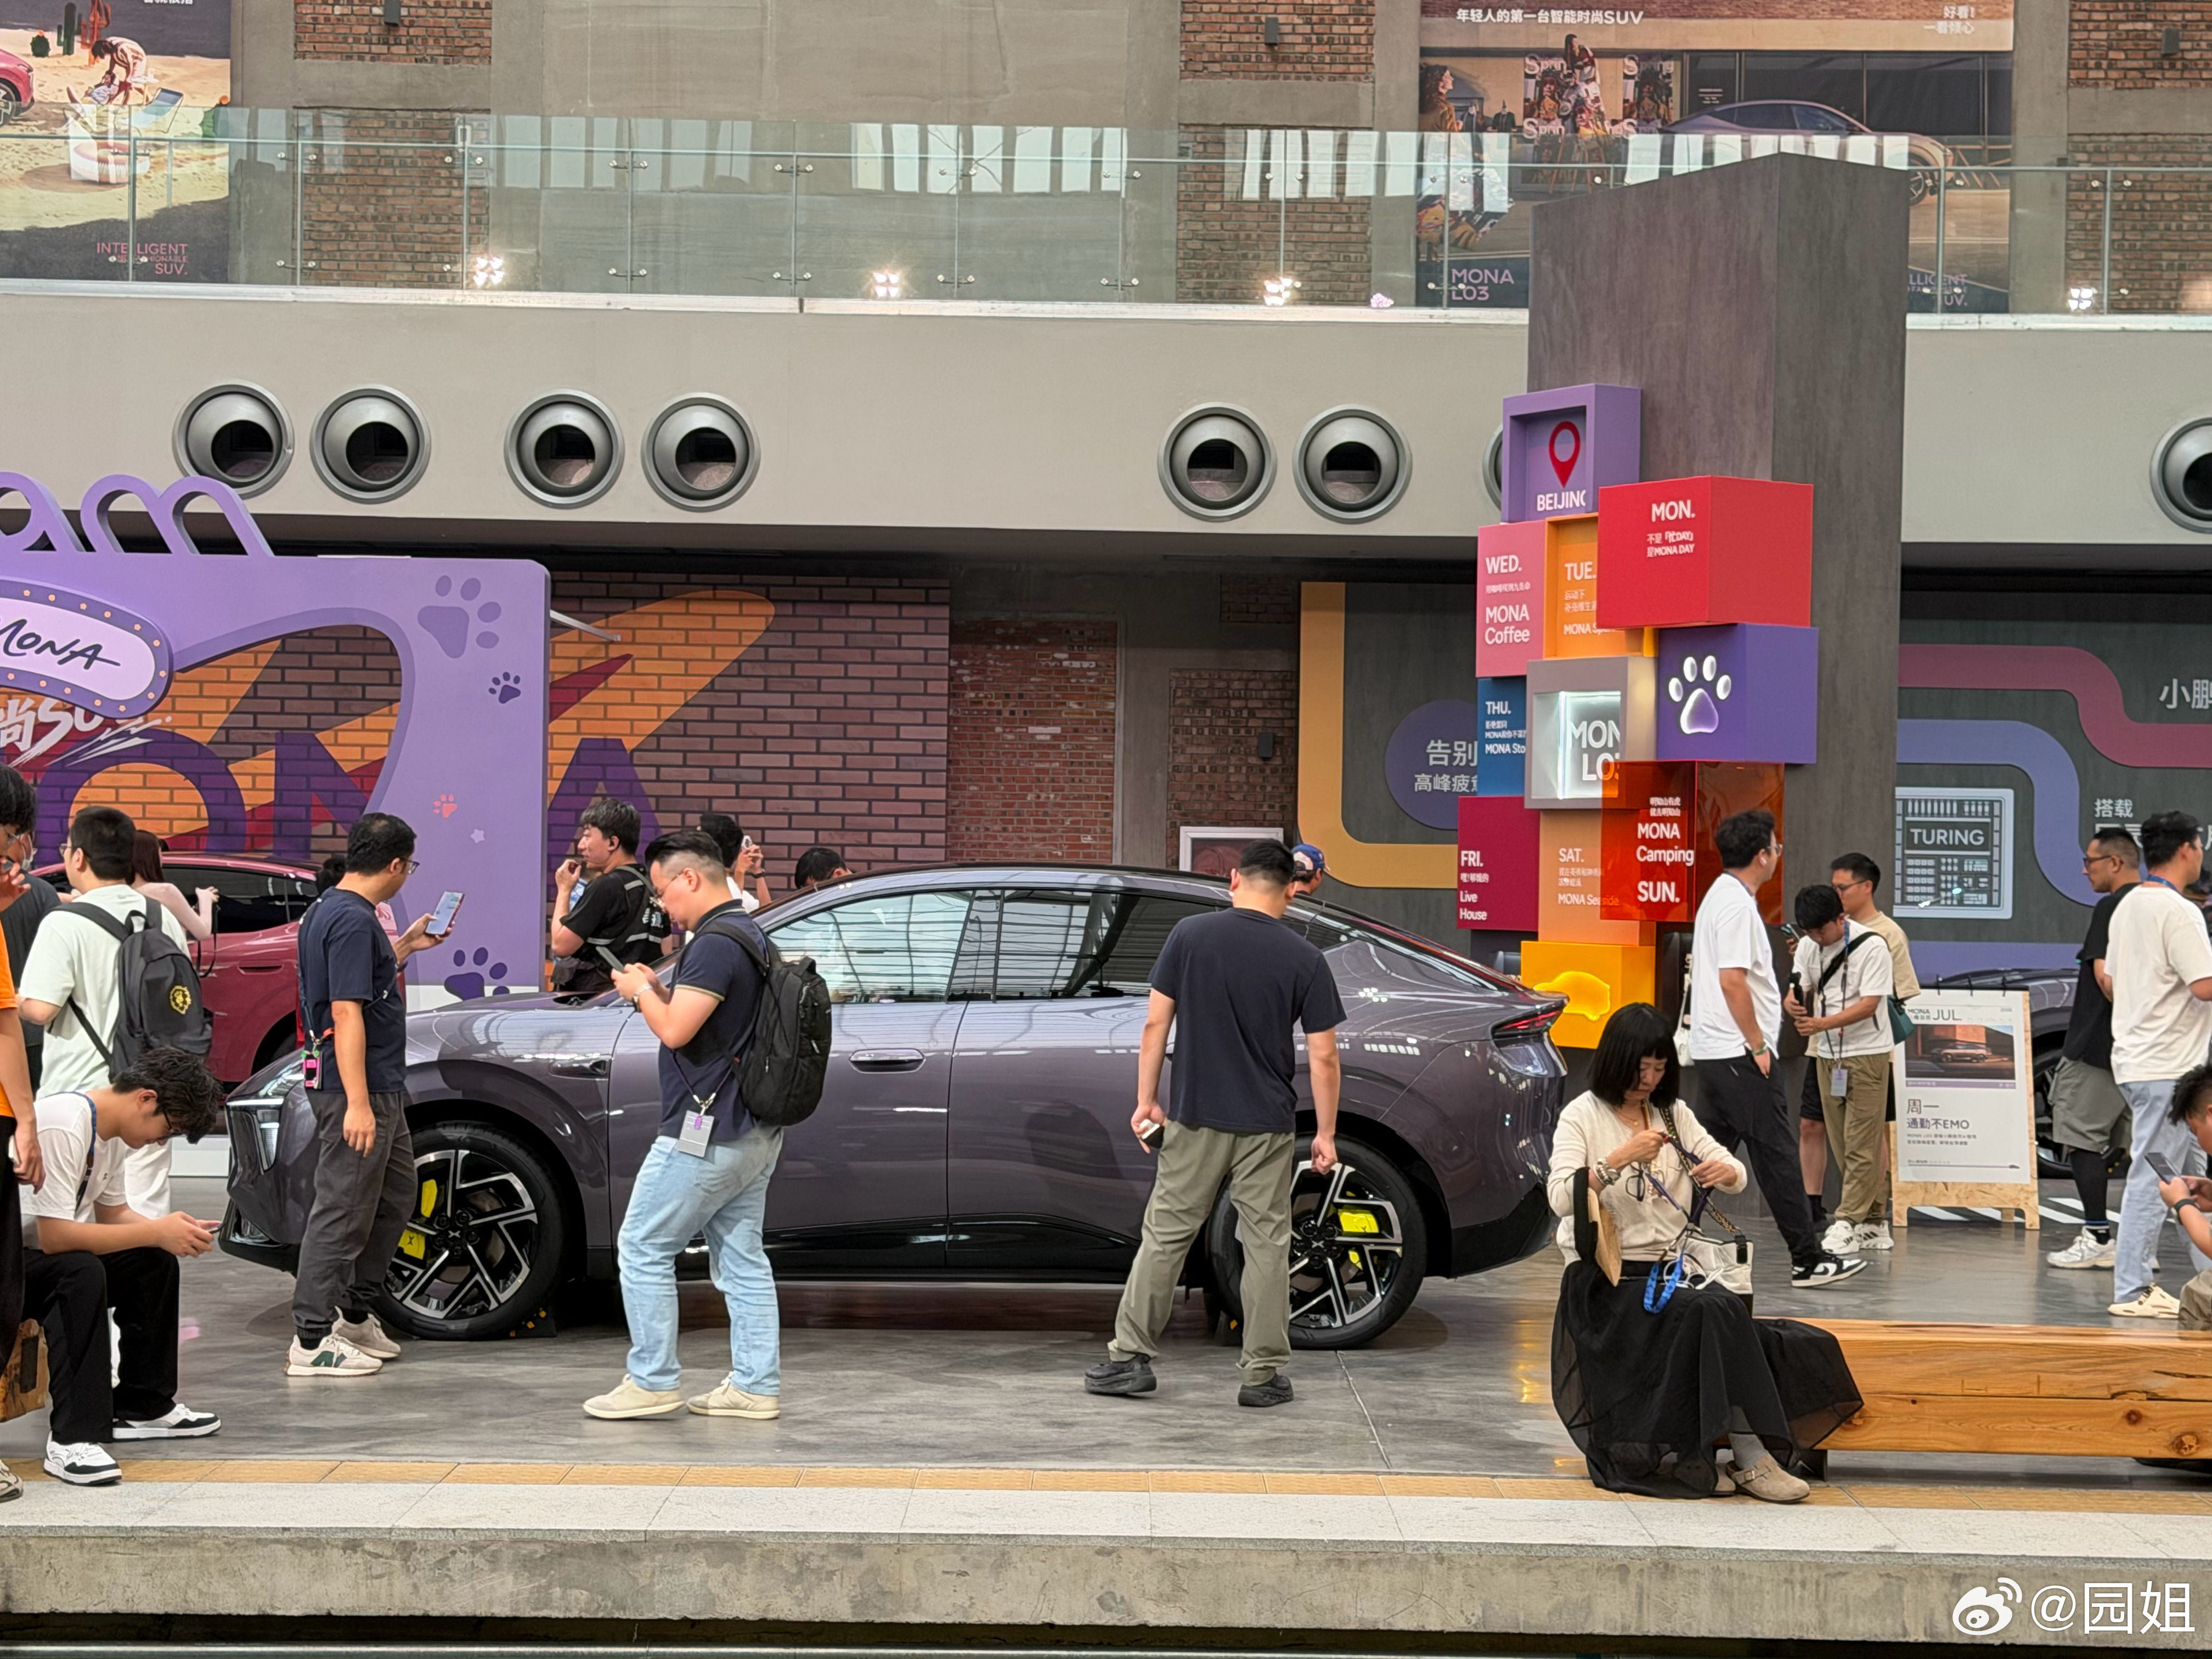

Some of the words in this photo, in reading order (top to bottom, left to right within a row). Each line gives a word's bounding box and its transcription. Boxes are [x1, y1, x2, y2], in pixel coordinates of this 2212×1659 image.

[1455, 8, 1644, 25] 年轻人的第一台智能时尚SUV
[97, 242, 188, 255] INTELIGENT
[155, 263, 188, 275] SUV.
[1451, 268, 1515, 284] MONA
[1651, 499, 1696, 522] MON.
[1486, 555, 1522, 574] WED.
[1565, 561, 1596, 581] TUE.
[1486, 604, 1530, 624] MONA
[1485, 626, 1531, 645] Coffee
[1563, 623, 1592, 635] MONA
[1485, 701, 1511, 715] THU.
[1567, 720, 1620, 749] MON
[1426, 739, 1478, 767] 告别
[1485, 743, 1511, 755] MONA
[1512, 743, 1526, 754] Sto
[2094, 798, 2134, 818] 搭载
[1638, 822, 1681, 840] MONA
[1910, 828, 1984, 845] TURING
[1461, 850, 1484, 867] FRI.
[1559, 848, 1584, 863] SAT.
[1636, 845, 1695, 867] Camping
[1459, 890, 1478, 903] Live
[1558, 893, 1586, 905] MONA
[1638, 881, 1680, 903] SUN.
[1459, 908, 1487, 921] House
[1933, 1009, 1962, 1021] JUL
[1906, 1098, 1940, 1115] 周一
[1906, 1118, 1970, 1130] 通勤不EMO
